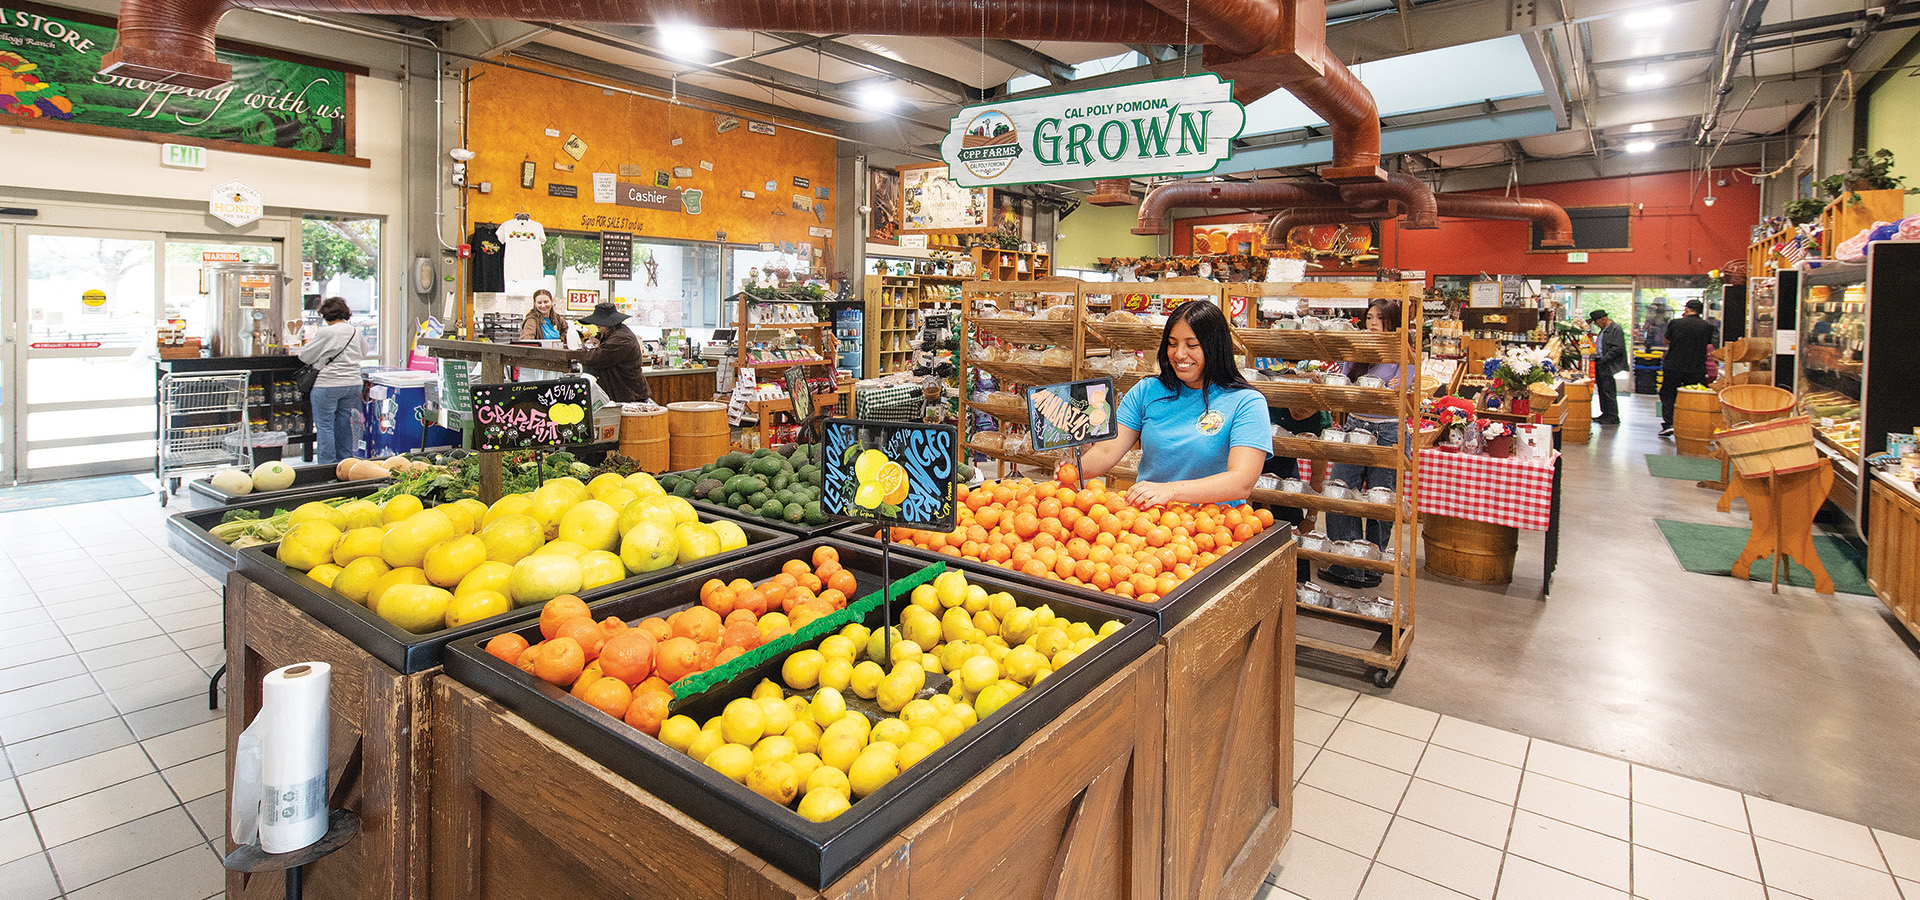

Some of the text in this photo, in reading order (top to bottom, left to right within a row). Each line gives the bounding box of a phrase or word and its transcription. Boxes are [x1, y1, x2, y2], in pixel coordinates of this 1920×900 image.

[0, 32, 56, 49] ellogg Ranch
[15, 11, 95, 54] STORE
[243, 78, 330, 114] with
[315, 101, 346, 120] us.
[1064, 98, 1169, 119] CAL POLY POMONA
[1033, 102, 1214, 168] GROWN
[170, 145, 201, 166] EXIT
[963, 146, 1016, 160] CPP FARMS
[628, 187, 668, 205] Cashier
[214, 202, 260, 214] HONEY
[581, 214, 595, 230] Signs
[595, 214, 606, 227] FOR
[607, 216, 620, 229] SALE
[1319, 226, 1368, 249] Self Serve
[203, 253, 239, 261] WARNING
[1331, 243, 1363, 255] Honey
[570, 292, 598, 303] EBT
[478, 404, 559, 443] GRAPEFRUIT
[1030, 388, 1090, 441] MANDARINS
[823, 423, 855, 515] LEMONS
[902, 429, 952, 522] ORANGES
